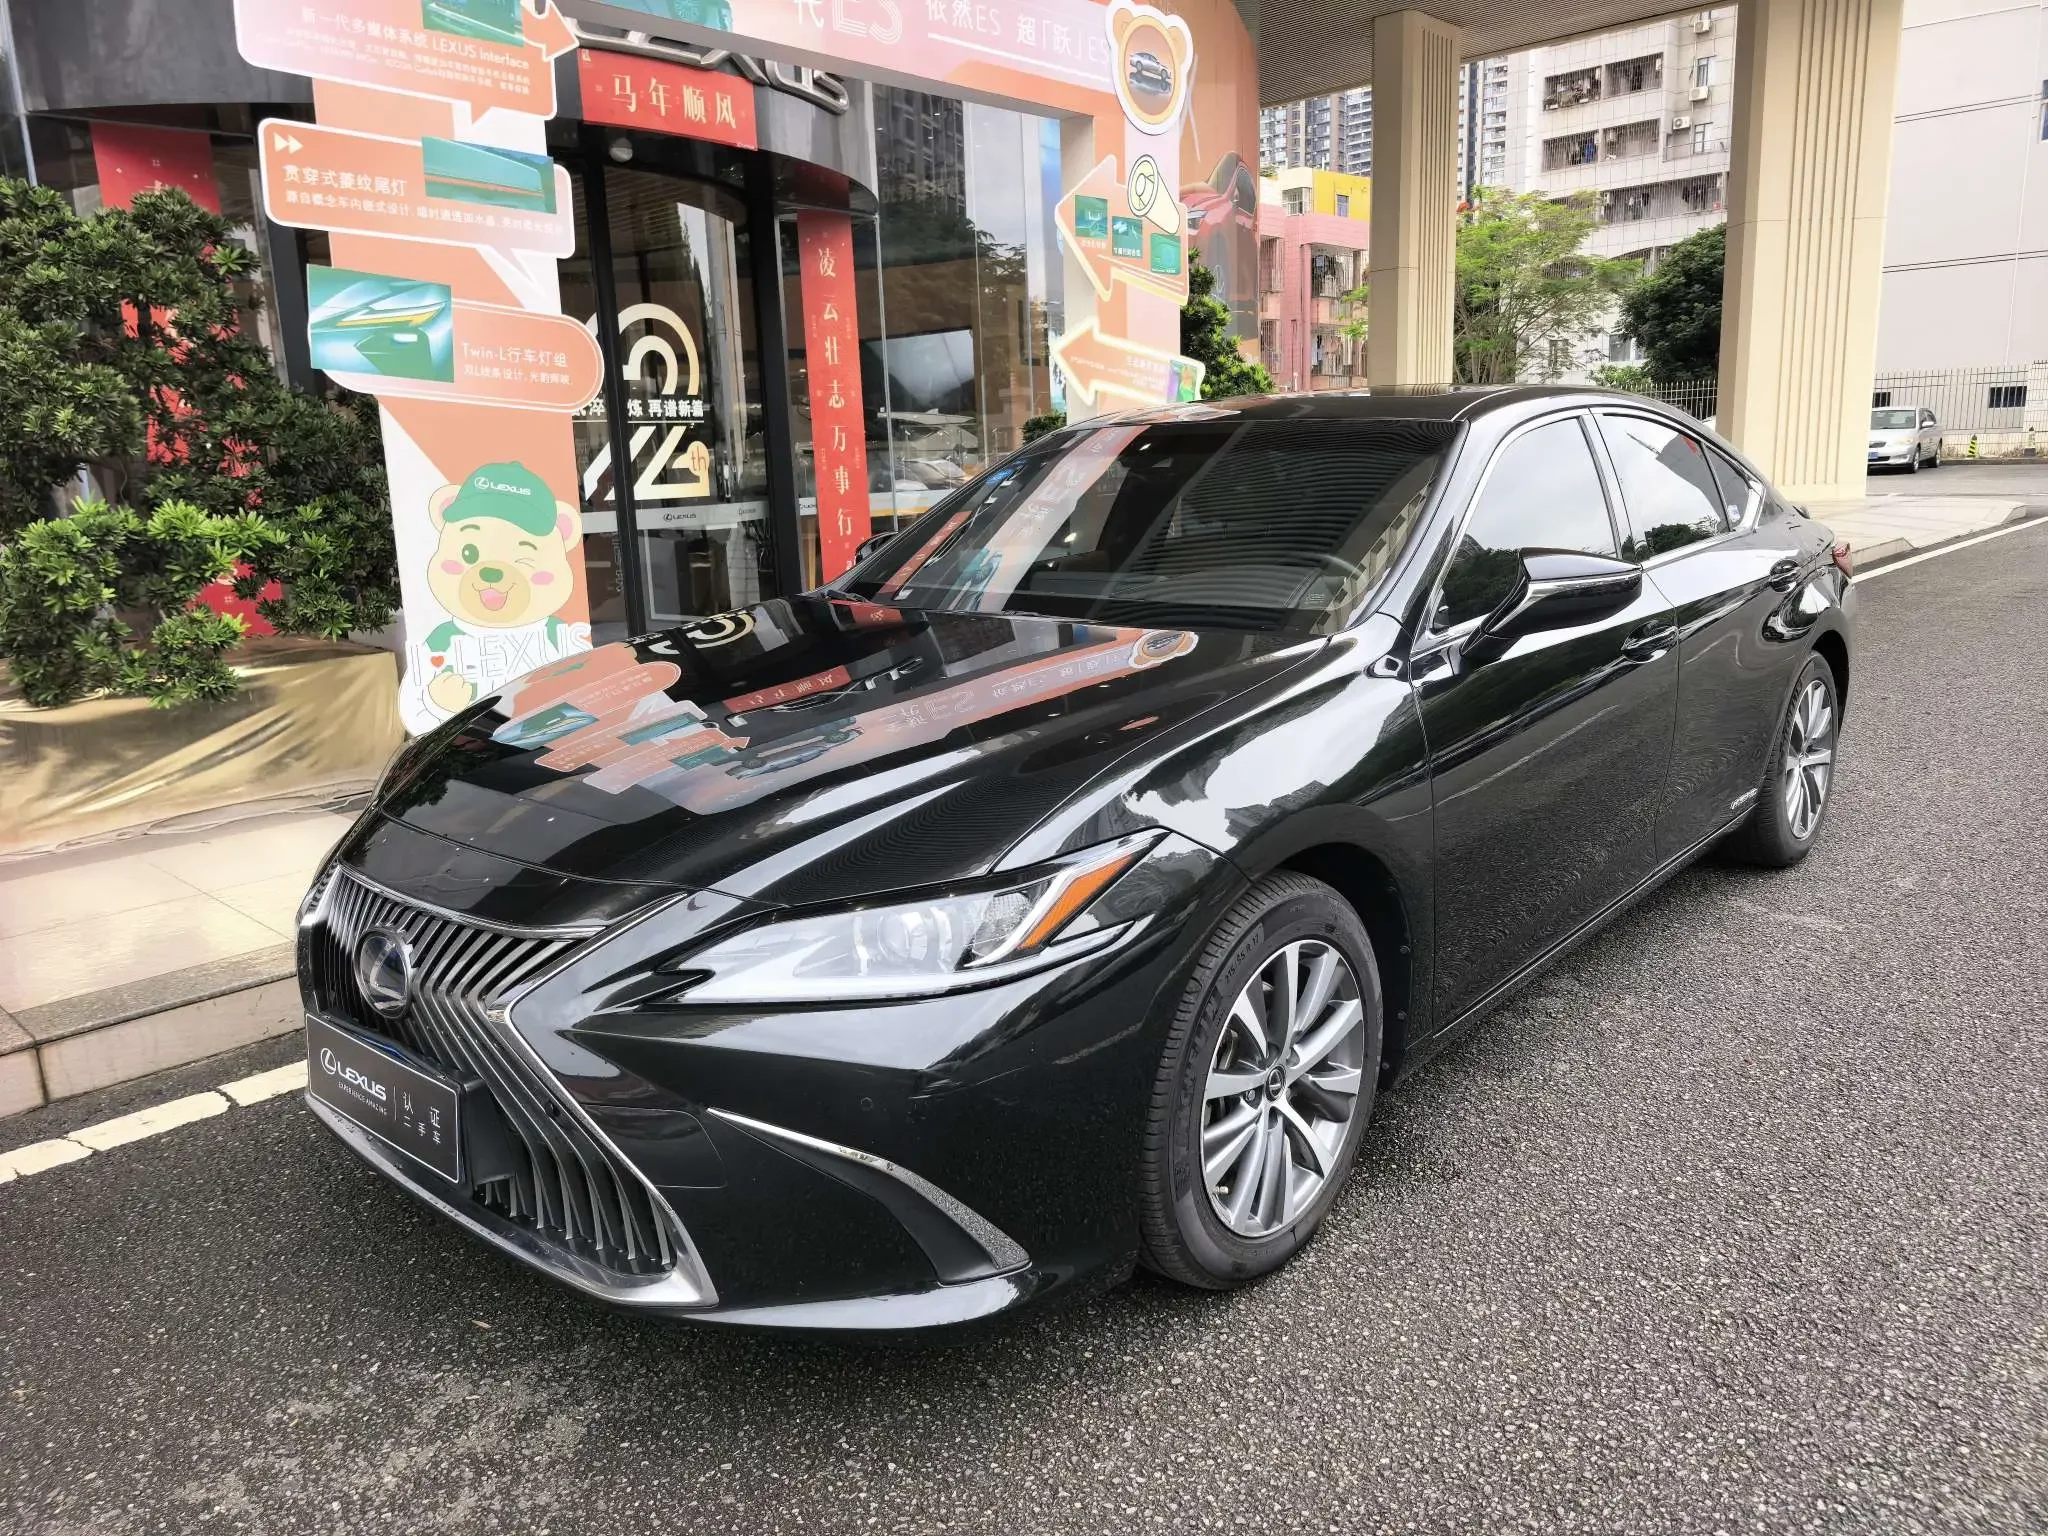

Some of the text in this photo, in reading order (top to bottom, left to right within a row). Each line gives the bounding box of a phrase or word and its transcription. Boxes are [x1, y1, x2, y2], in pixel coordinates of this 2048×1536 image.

[301, 7, 429, 50] 新一代多媒体系统
[432, 35, 477, 59] LEXUS
[612, 74, 737, 129] 马年顺风
[283, 164, 407, 197] 贯穿式菱纹尾灯
[648, 399, 704, 417] 再谱新篇
[818, 248, 853, 537] 凌云壮志万事行
[690, 445, 706, 473] th
[490, 481, 531, 497] LEXUS
[454, 622, 592, 682] LEXUS
[337, 1060, 387, 1102] LEXUS
